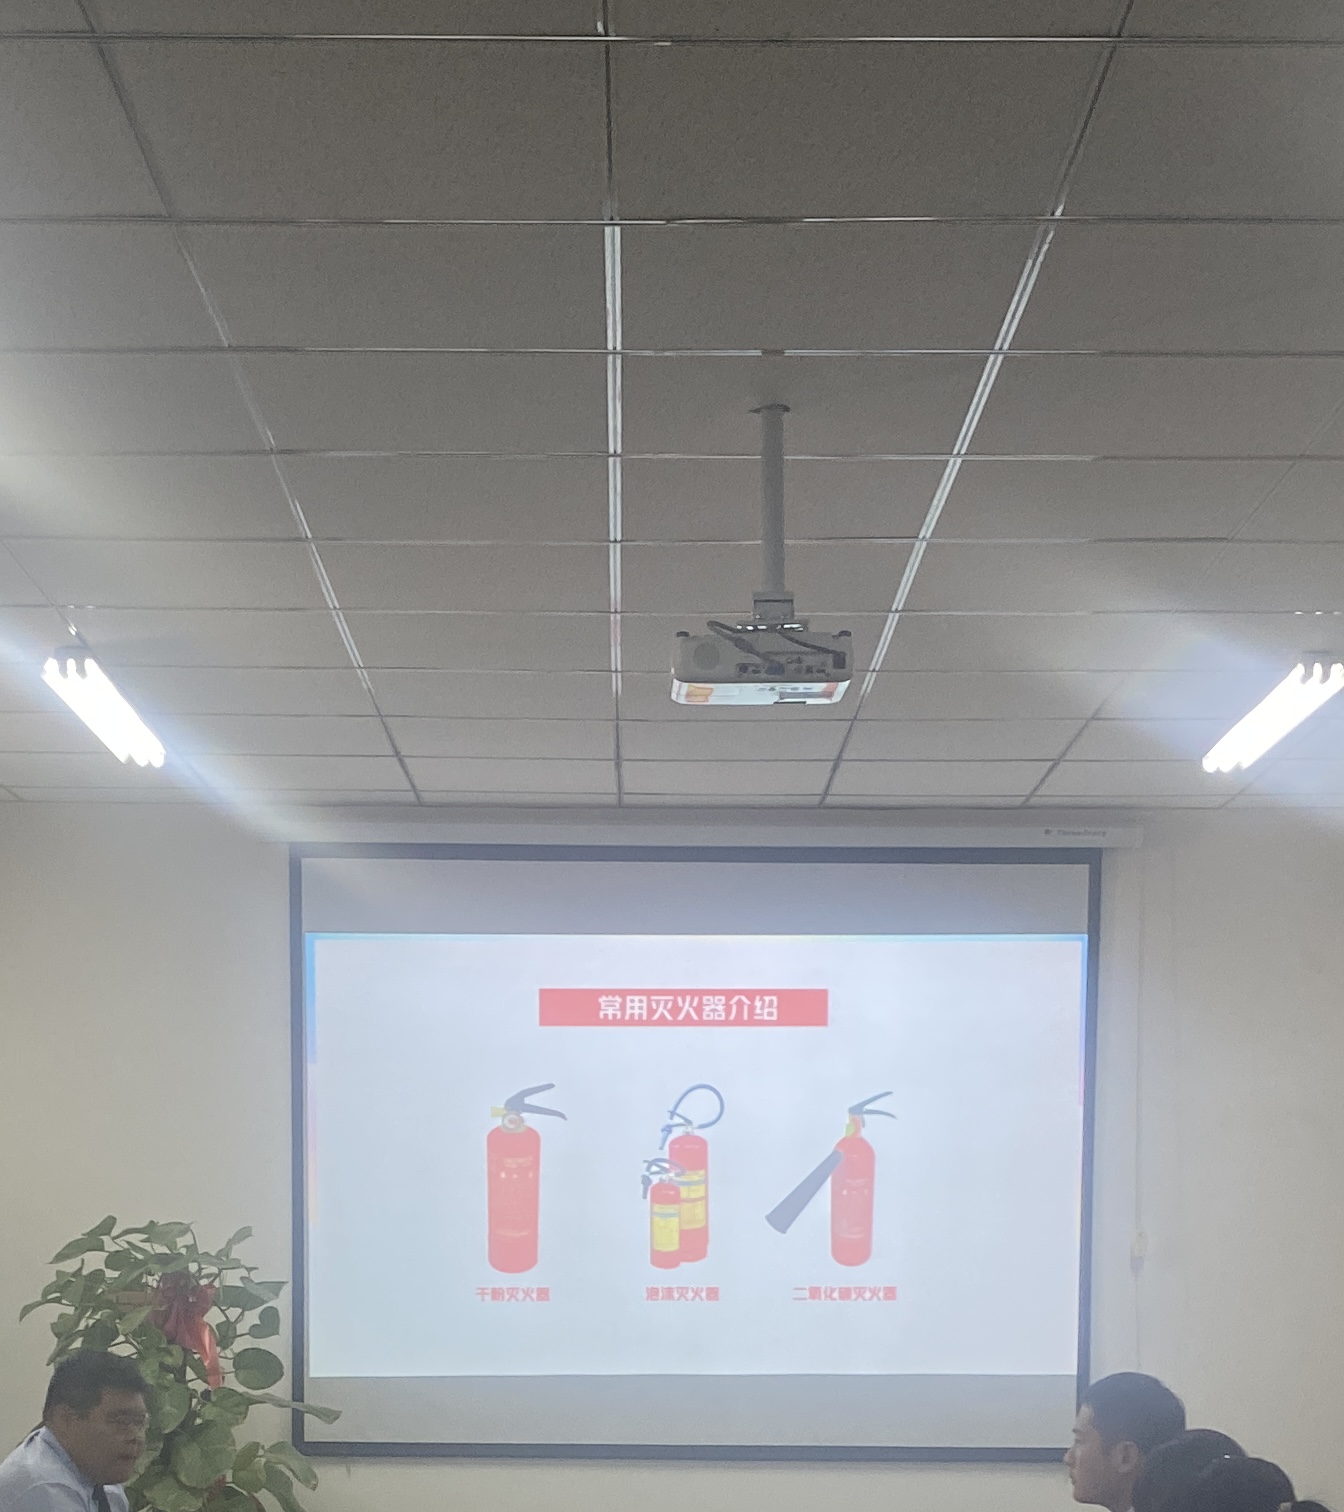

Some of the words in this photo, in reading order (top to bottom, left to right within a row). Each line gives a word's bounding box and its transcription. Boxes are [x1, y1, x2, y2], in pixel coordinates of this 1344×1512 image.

[598, 995, 778, 1021] 常用灭火器介绍
